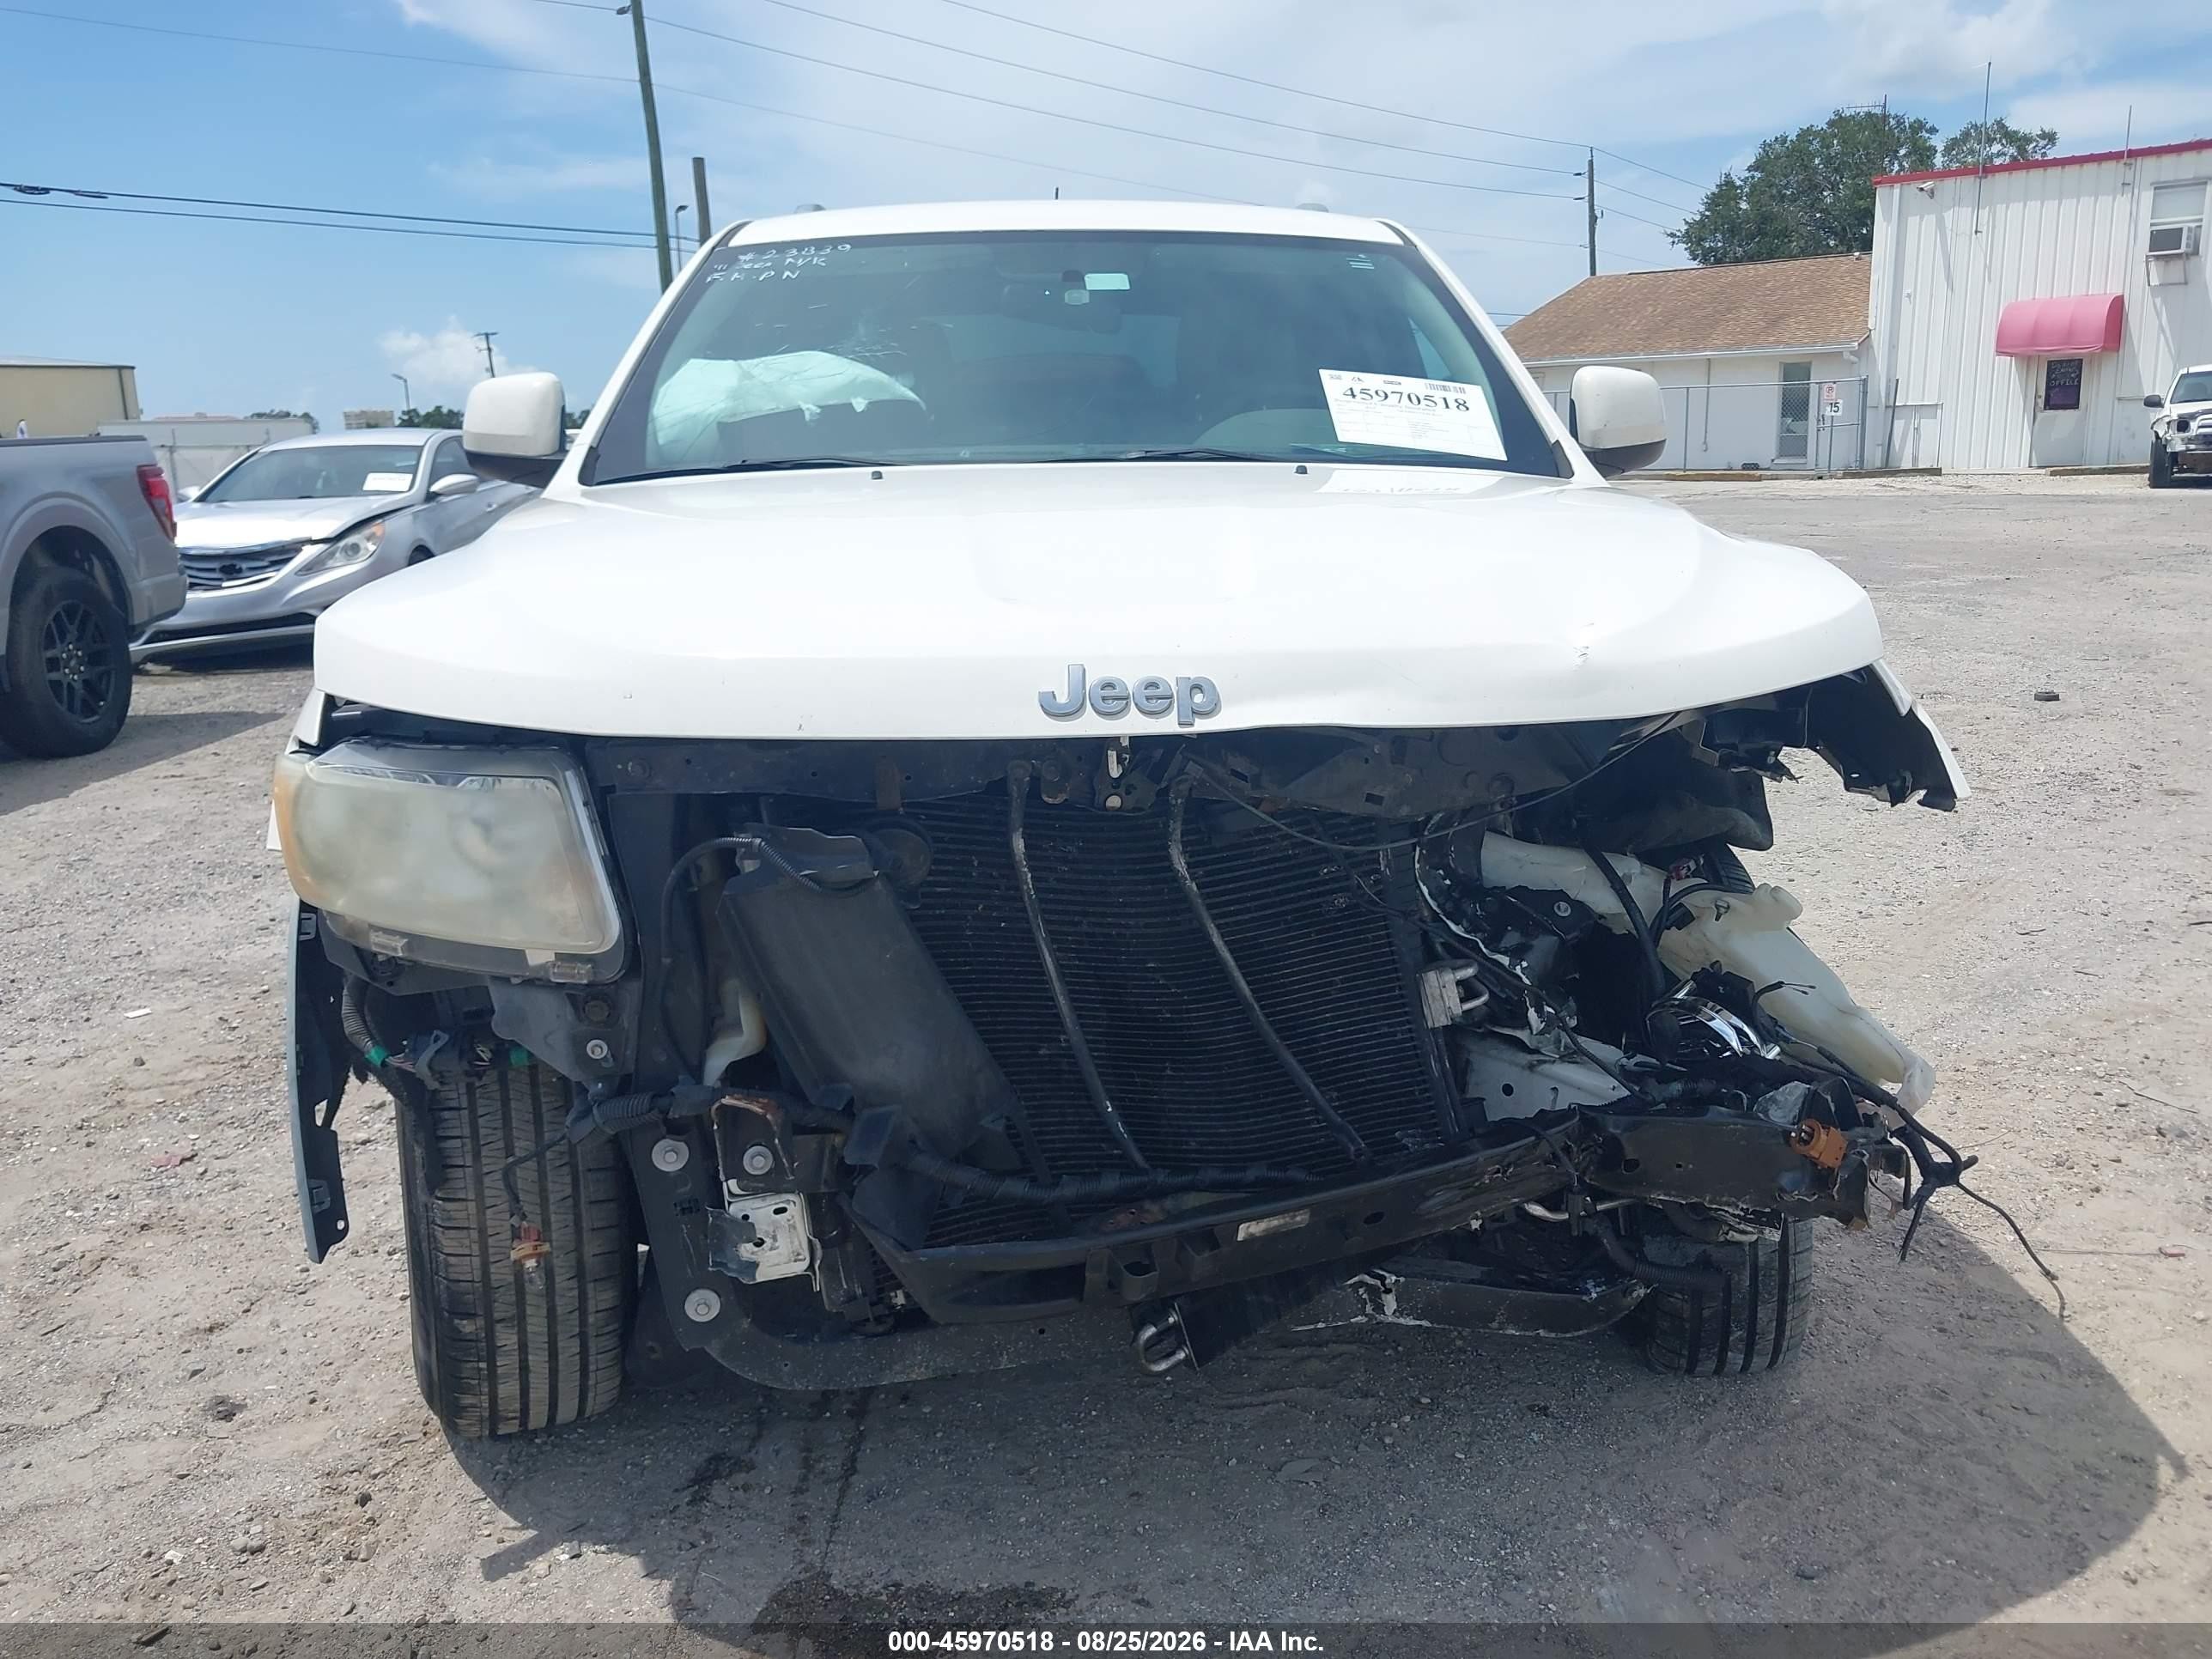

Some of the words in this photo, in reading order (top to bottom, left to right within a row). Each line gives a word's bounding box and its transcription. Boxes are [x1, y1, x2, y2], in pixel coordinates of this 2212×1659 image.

[1342, 386, 1469, 412] 45970518
[1829, 402, 1839, 413] 15
[1038, 663, 1221, 728] Jeep
